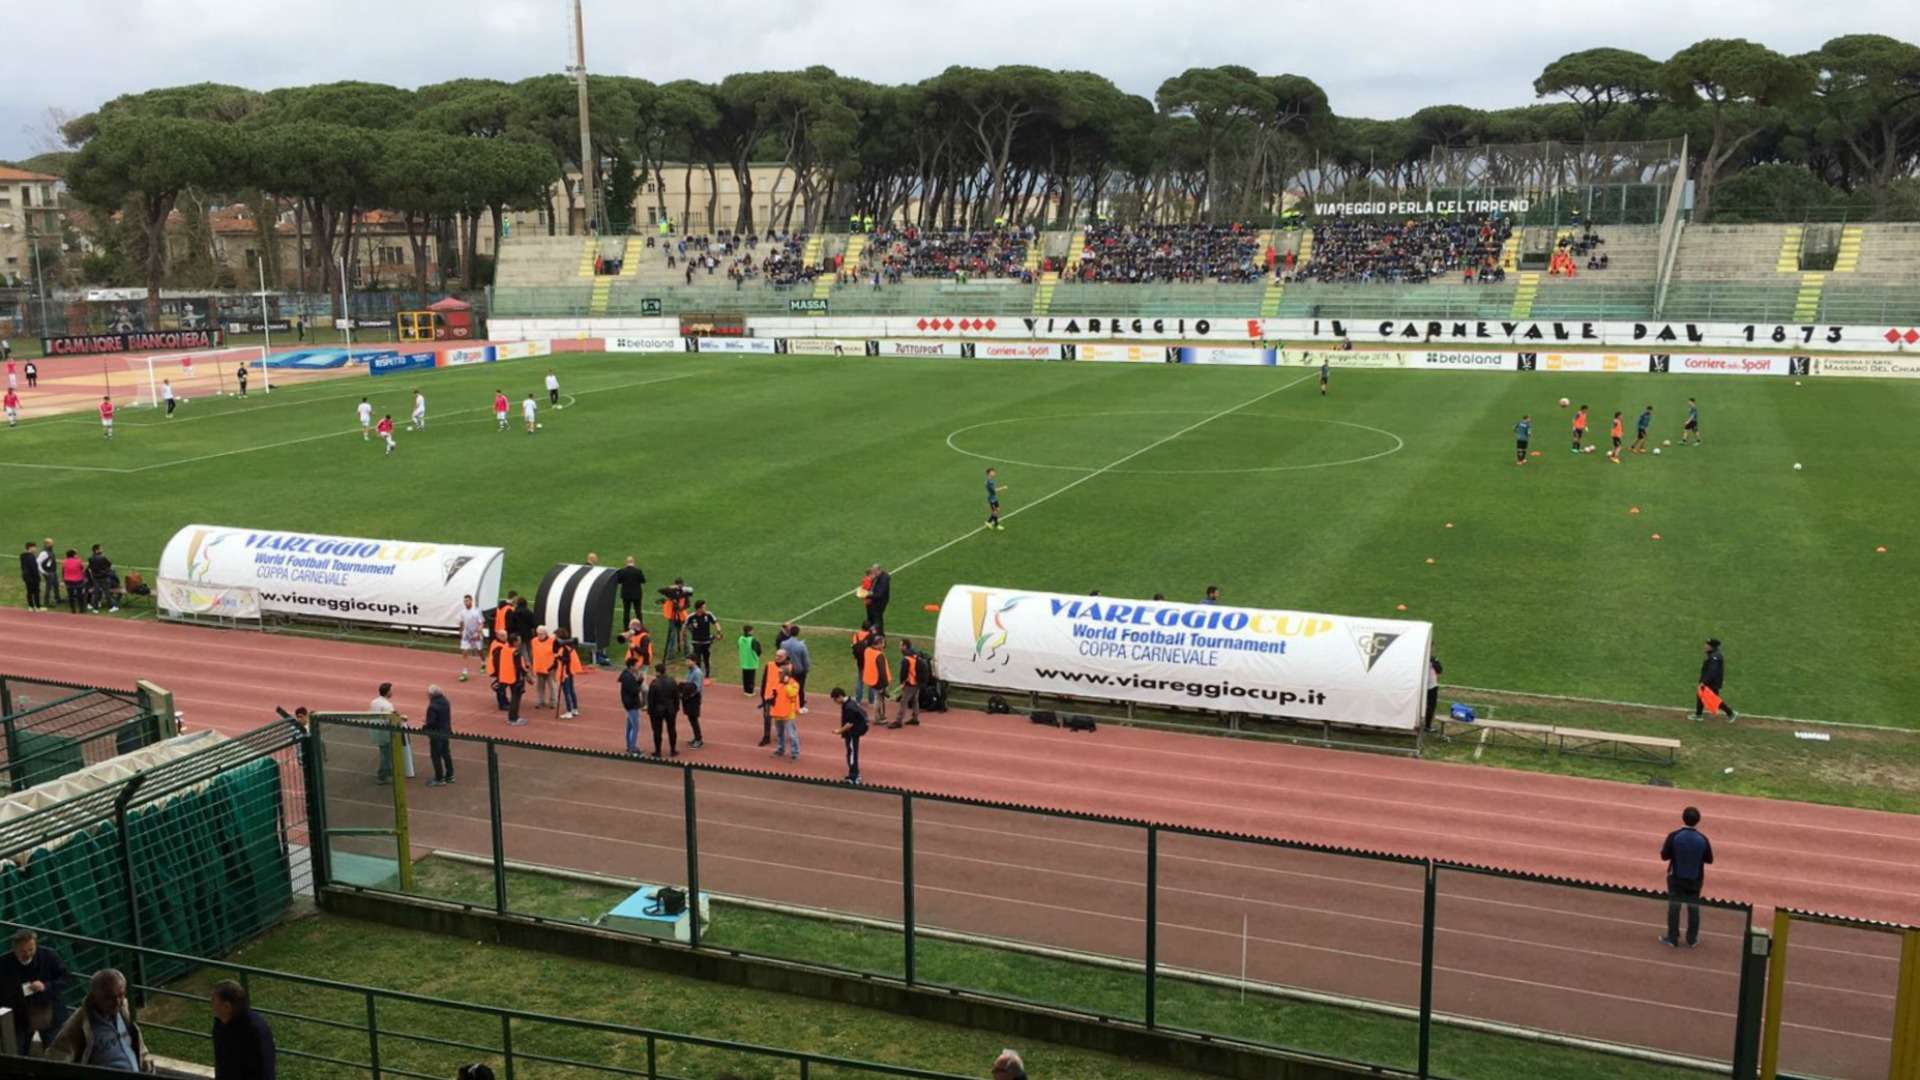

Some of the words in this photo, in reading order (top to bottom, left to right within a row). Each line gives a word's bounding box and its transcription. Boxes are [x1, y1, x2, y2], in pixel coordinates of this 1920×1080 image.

[1315, 201, 1385, 215] VIAREGGIO
[1389, 200, 1434, 214] PERLA
[791, 300, 826, 310] MASSA
[1024, 318, 1210, 335] VIAREGGIO
[1314, 319, 1347, 337] IL
[1379, 321, 1598, 340] CARNEVALE
[1634, 323, 1703, 342] DAL
[1743, 325, 1843, 343] 1873
[627, 338, 674, 349] betaland
[896, 343, 944, 355] TUTTOSPORT
[1027, 345, 1049, 359] Sport
[1439, 352, 1502, 365] betaland
[1684, 357, 1726, 369] Corriere
[1742, 357, 1772, 372] Sport
[254, 552, 284, 566] World
[286, 554, 331, 570] Football
[331, 559, 396, 576] Tournament
[256, 565, 289, 579] COPPA
[290, 570, 349, 587] CARNEVALE
[259, 590, 418, 616] w.viareggiocup.it
[1072, 622, 1116, 641] World
[1121, 627, 1185, 645] Football
[1190, 633, 1287, 655] Tournament
[1078, 639, 1128, 660] COPPA
[1131, 645, 1218, 667] CARNEVALE
[1035, 666, 1327, 707] www.viareggiocup.it
